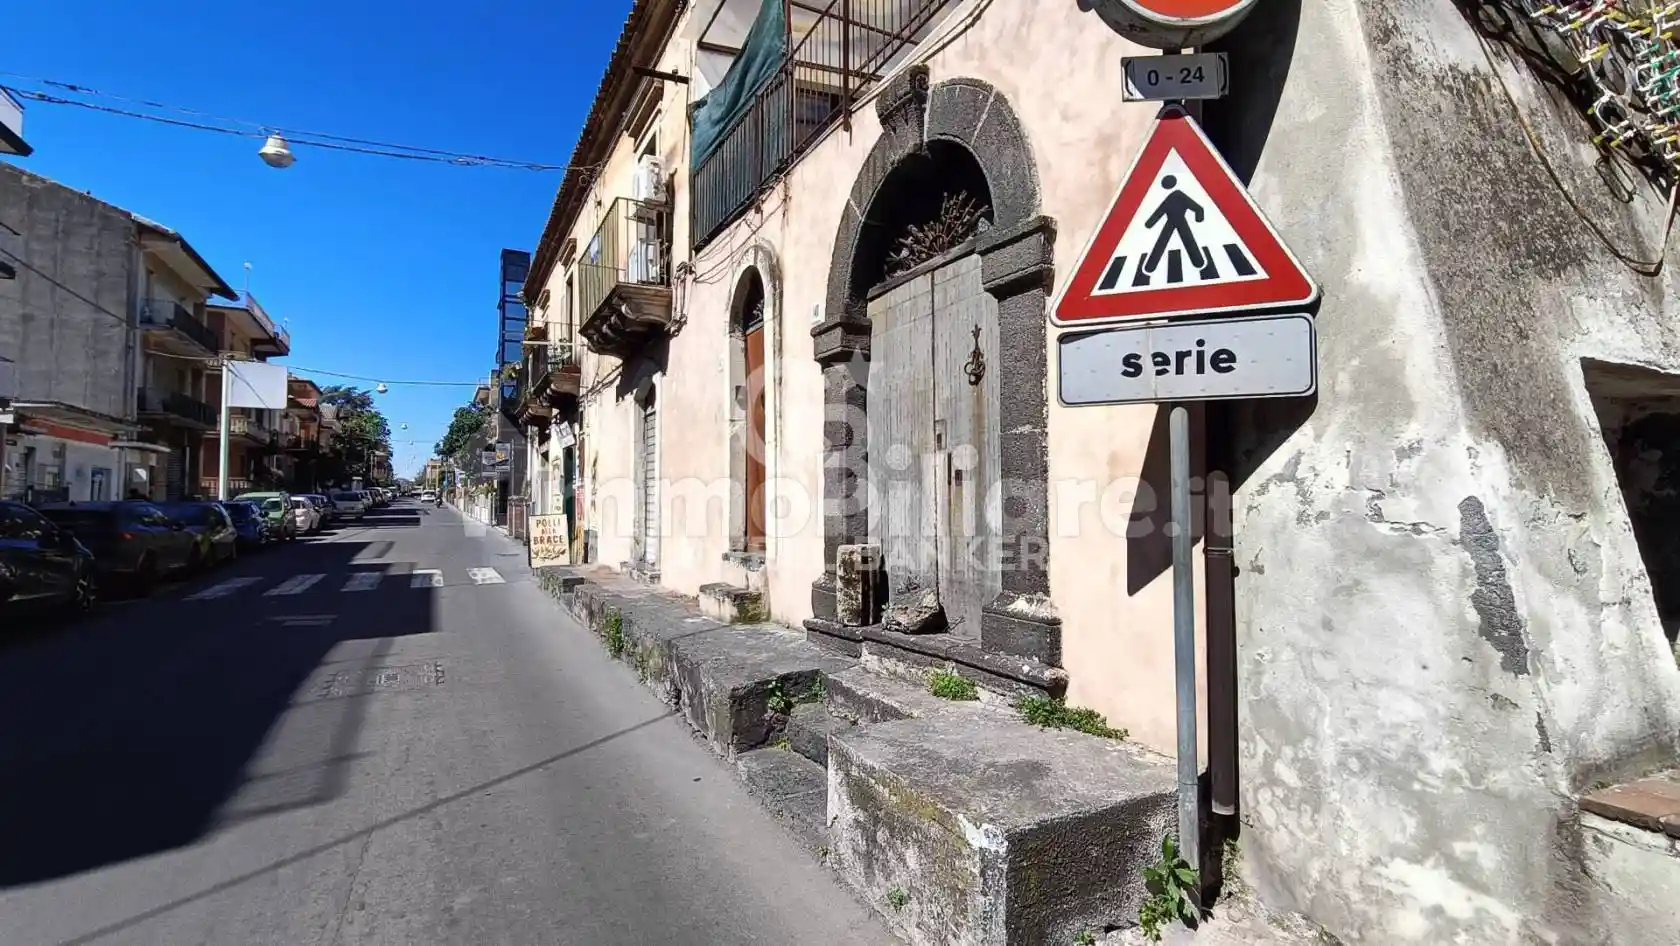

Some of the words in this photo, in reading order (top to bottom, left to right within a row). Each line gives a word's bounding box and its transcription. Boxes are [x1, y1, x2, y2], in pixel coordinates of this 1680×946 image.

[1147, 69, 1159, 86] 0
[1180, 66, 1205, 84] 24
[1120, 338, 1237, 378] serie
[536, 519, 560, 528] POLLI
[534, 535, 563, 545] BRACE
